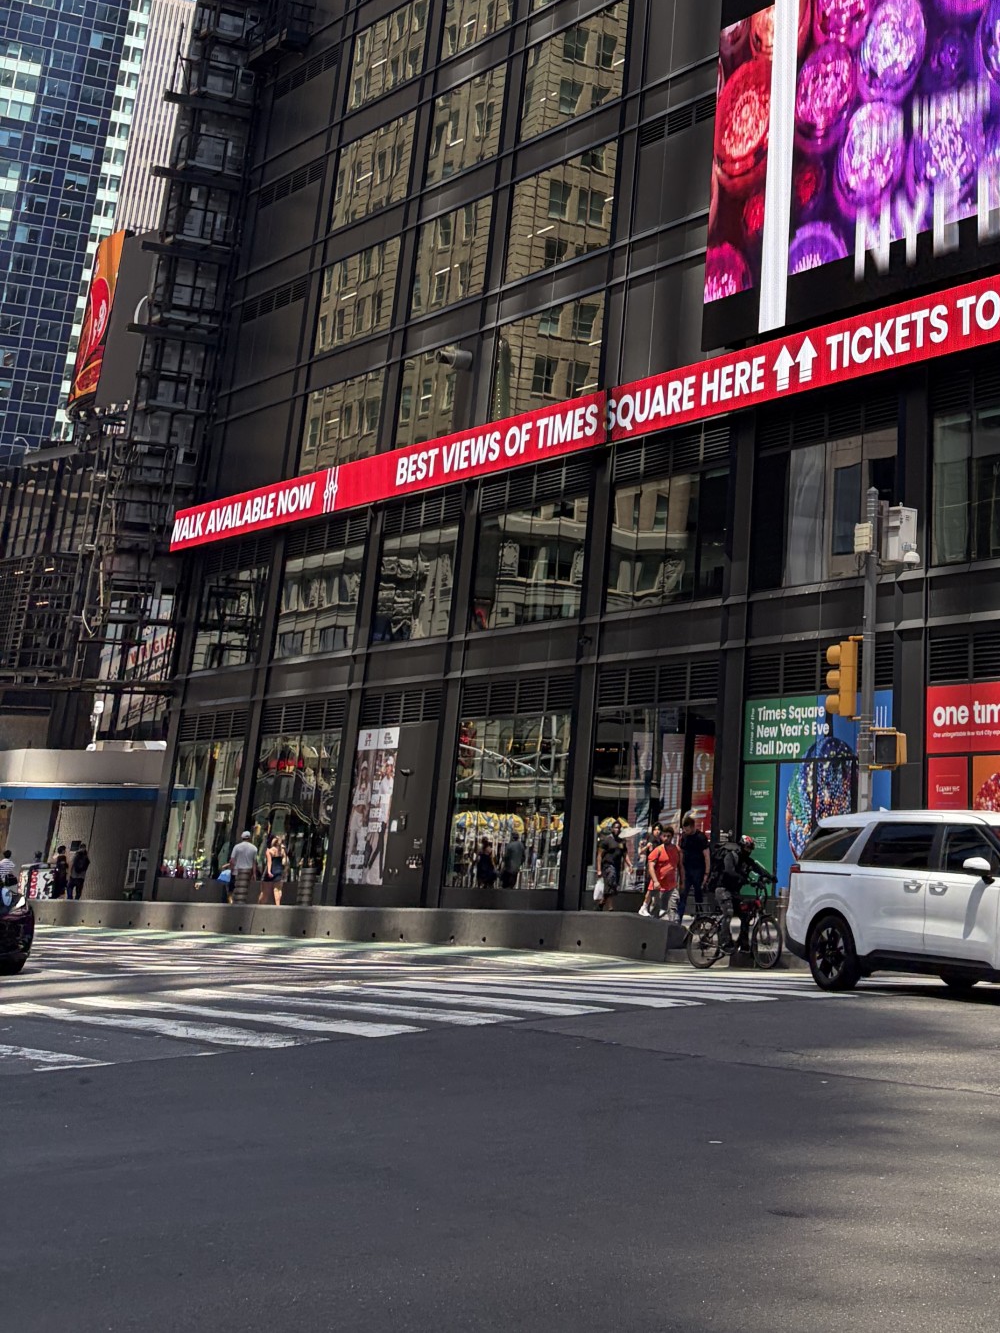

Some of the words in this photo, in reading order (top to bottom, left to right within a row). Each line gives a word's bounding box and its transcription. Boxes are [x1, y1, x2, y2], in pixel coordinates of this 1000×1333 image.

[396, 447, 440, 486] BEST
[442, 430, 501, 474] VIEWS
[504, 424, 532, 457] OF
[536, 404, 599, 449] TIMES
[603, 375, 696, 431] SQUARE
[701, 355, 766, 407] HERE
[825, 303, 949, 372] TICKETS
[205, 491, 278, 536] AVAILABLE
[277, 481, 316, 516] NOW
[757, 706, 787, 721] Times
[789, 705, 826, 723] Square
[933, 704, 970, 728] one
[756, 725, 778, 738] New
[780, 722, 810, 738] Year's
[811, 722, 830, 735] Eve
[755, 741, 775, 755] Ball
[776, 741, 801, 759] Drop
